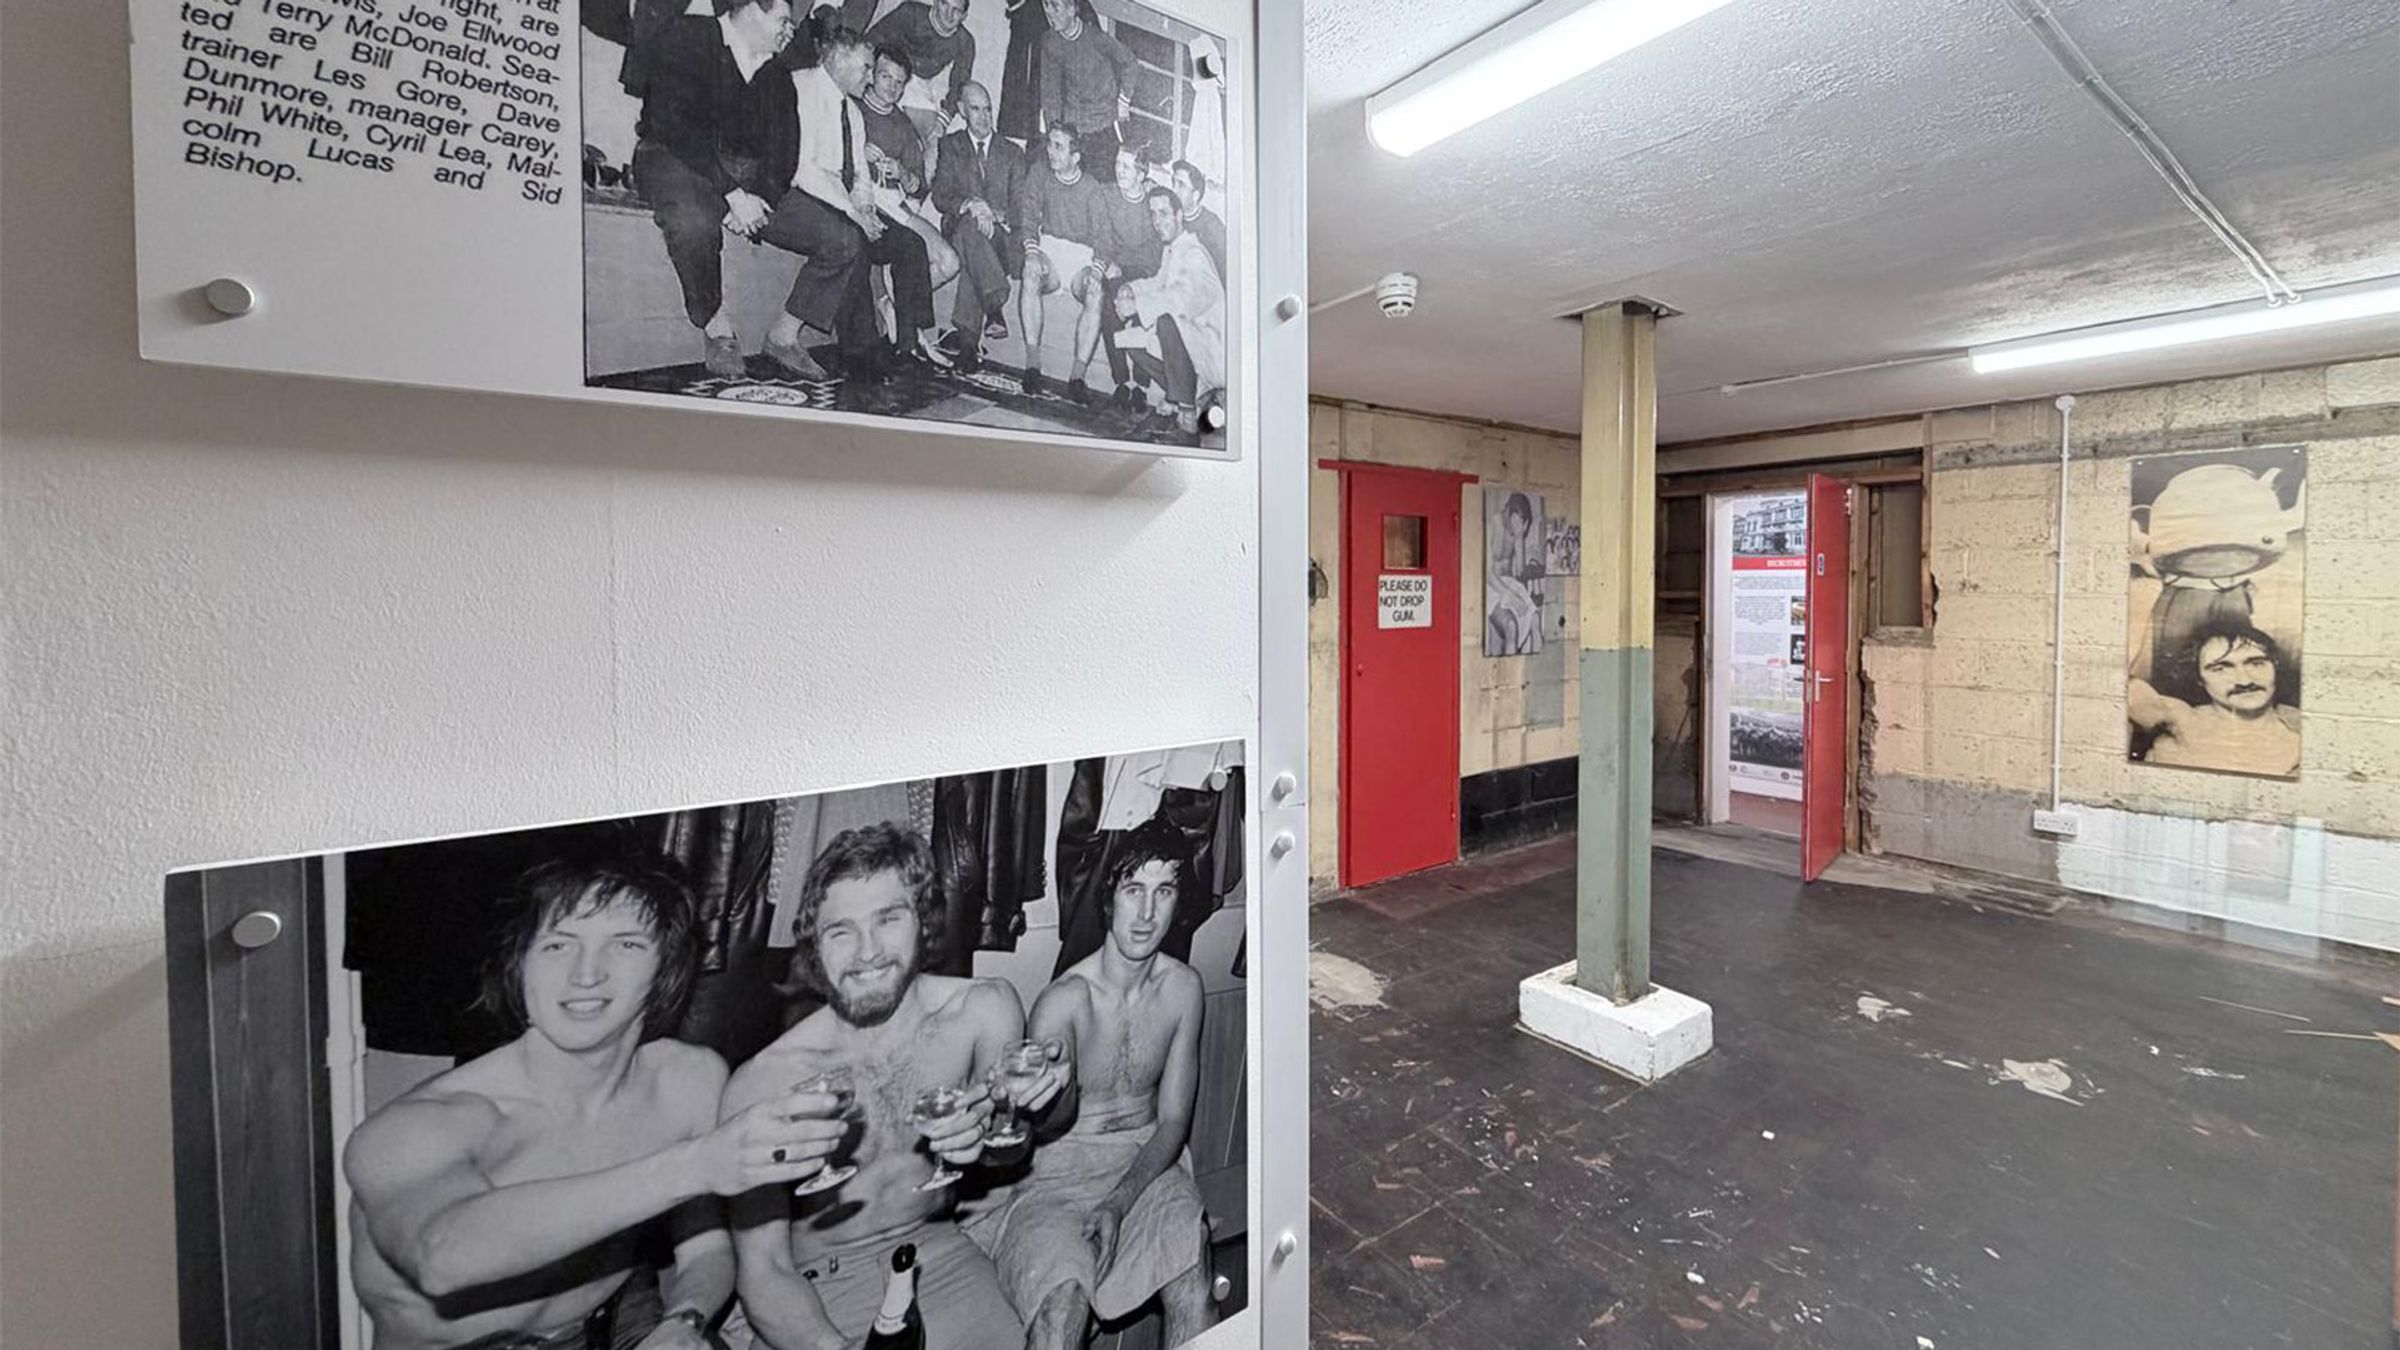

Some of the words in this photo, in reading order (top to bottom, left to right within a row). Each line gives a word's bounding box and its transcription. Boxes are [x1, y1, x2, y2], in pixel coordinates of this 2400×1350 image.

[180, 2, 235, 31] ted
[268, 26, 318, 52] are
[350, 41, 394, 70] Bill
[421, 58, 560, 113] Robertson,
[344, 14, 491, 69] McDonald.
[502, 54, 560, 84] Sea-
[398, 4, 449, 32] Joe
[462, 18, 561, 61] Ellwood
[520, 14, 560, 37] are
[181, 29, 284, 71] trainer
[313, 58, 367, 91] Les
[396, 79, 468, 116] Gore,
[496, 102, 561, 133] Dave
[182, 56, 333, 113] Dunmore,
[347, 98, 473, 137] manager
[480, 123, 559, 159] Carey,
[182, 118, 262, 148] colm
[306, 137, 395, 173] Lucas
[433, 166, 486, 190] and
[521, 179, 563, 205] Sid
[183, 85, 245, 118] Phil
[260, 100, 349, 143] White,
[366, 123, 428, 154] Cyril
[438, 138, 492, 170] Lea,
[506, 152, 562, 179] Mal-
[183, 141, 303, 184] Bishop.
[1379, 579, 1412, 592] PLEASE
[1414, 580, 1428, 592] DO
[1379, 595, 1398, 608] NOT
[1399, 595, 1425, 607] DROP
